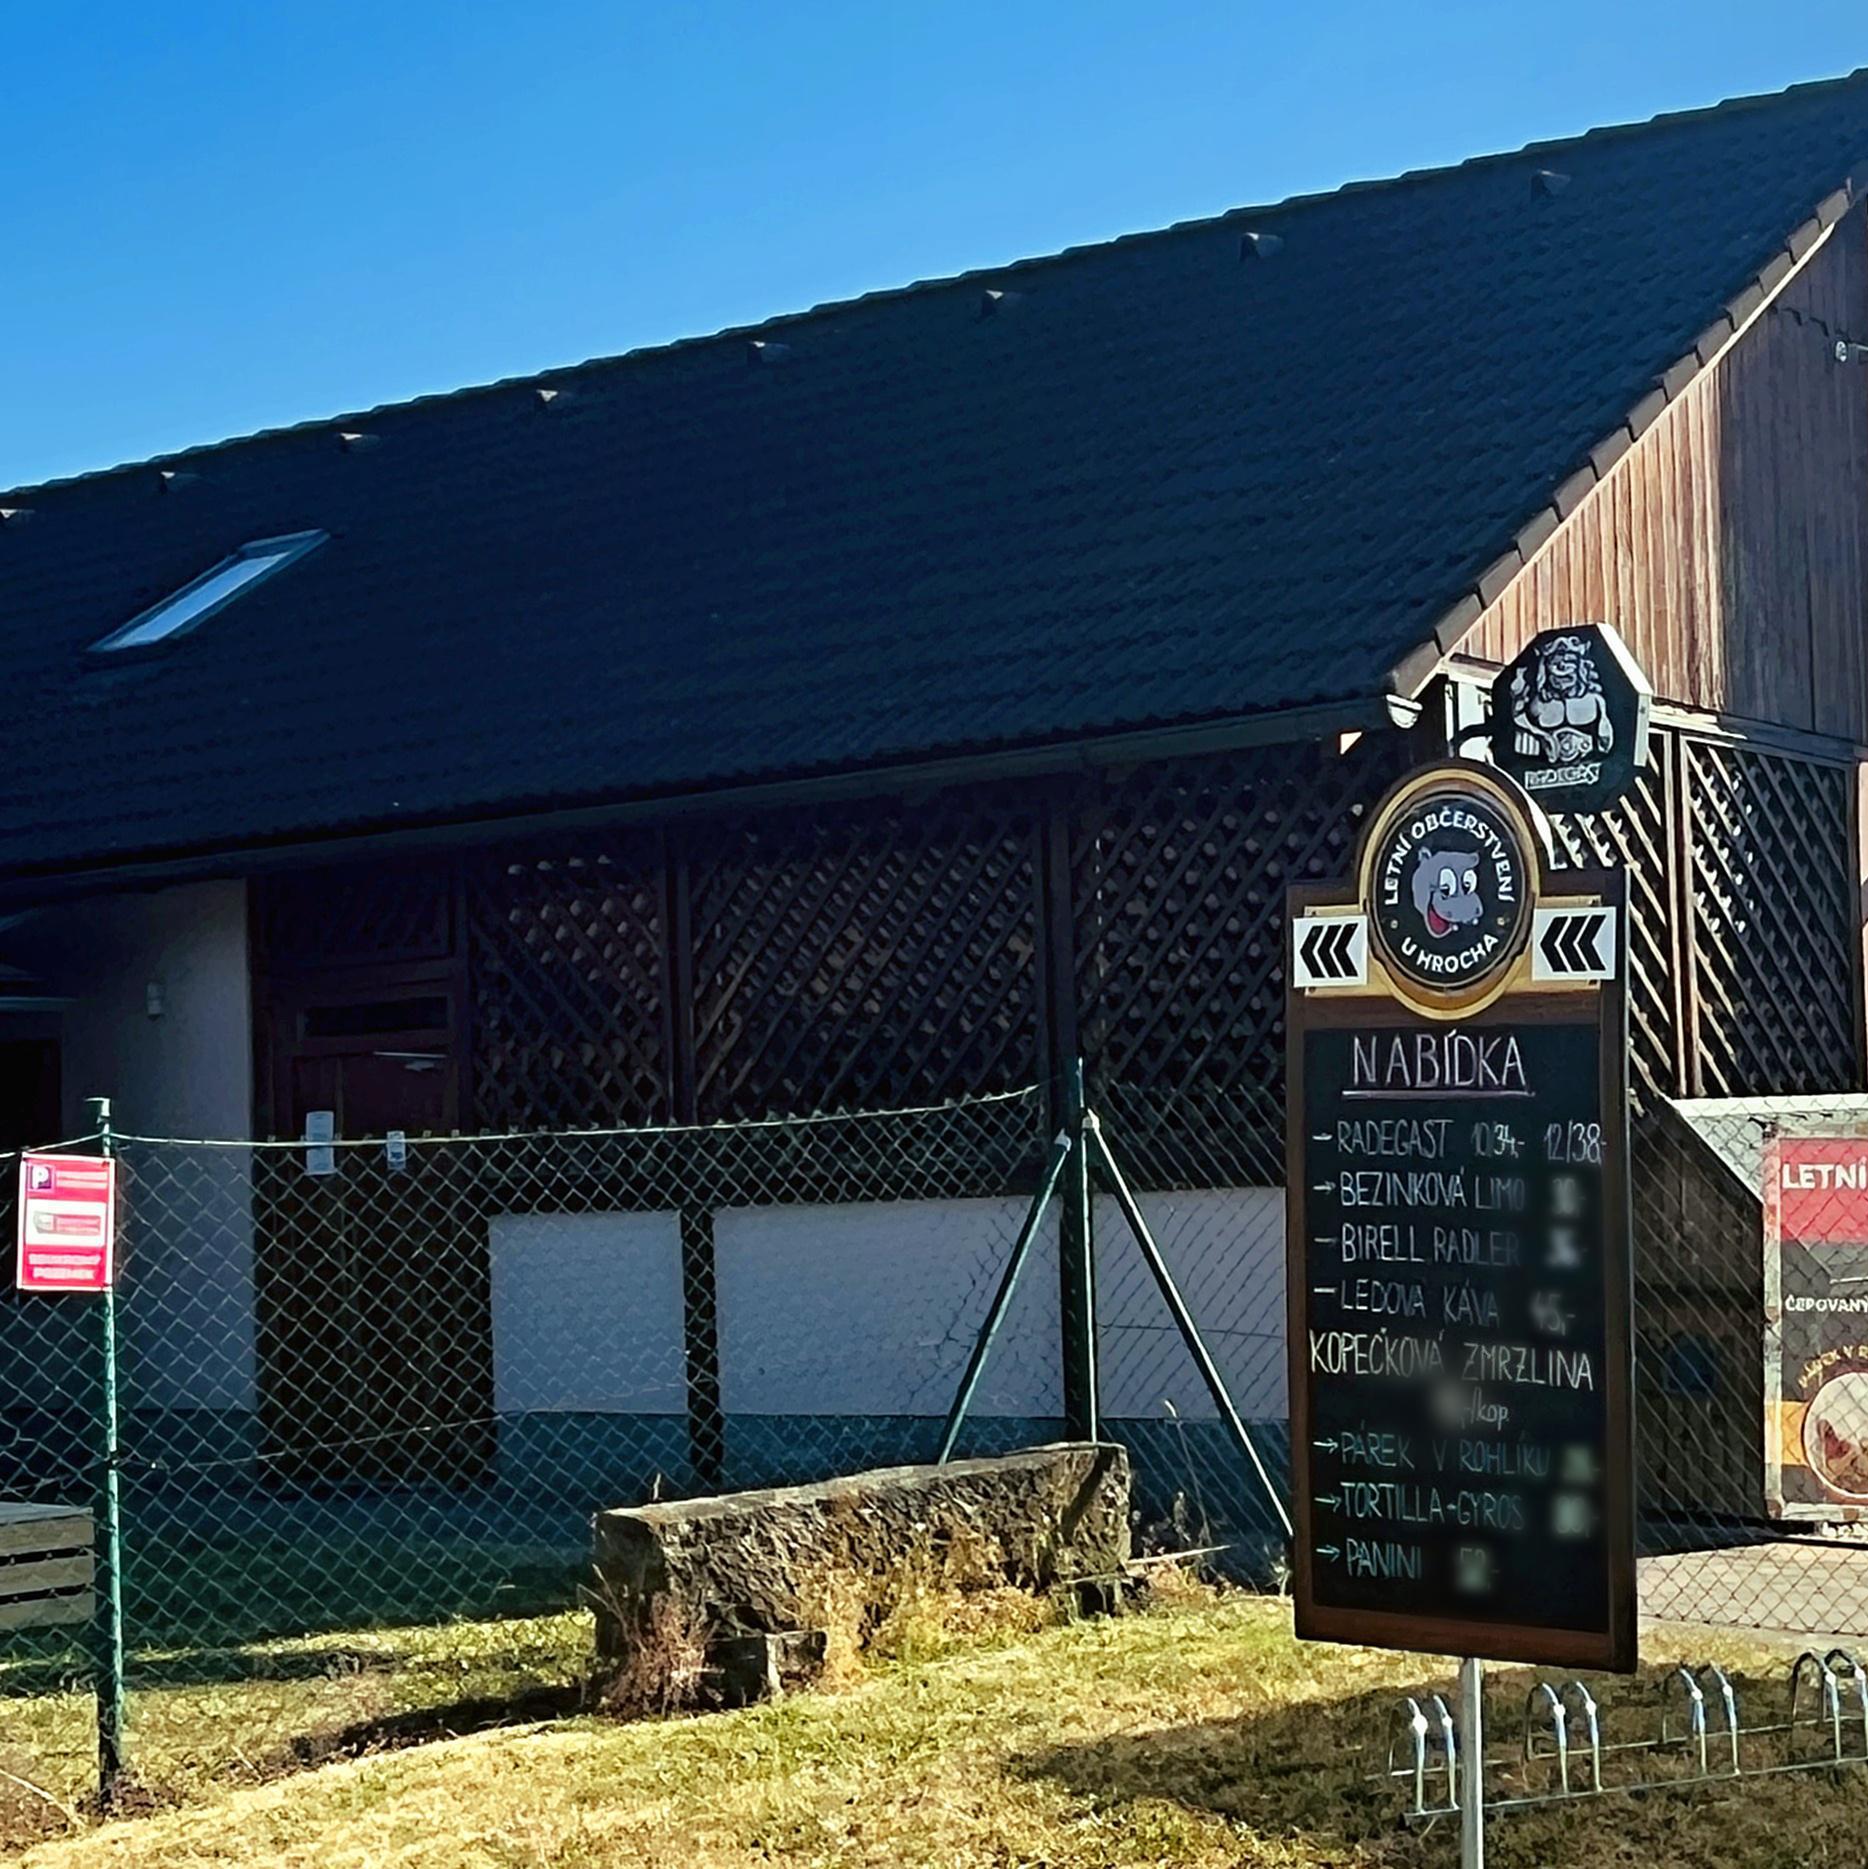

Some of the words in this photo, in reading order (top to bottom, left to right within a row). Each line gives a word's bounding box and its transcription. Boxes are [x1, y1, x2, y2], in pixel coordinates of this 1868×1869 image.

[1384, 831, 1413, 905] LETNÍ
[1413, 805, 1515, 902] OBČERSTVENÍ
[1400, 937, 1416, 957] U
[1415, 933, 1499, 974] HROCHA
[1352, 1029, 1527, 1087] NABÍDKA
[1336, 1119, 1453, 1158] RADEGAST
[1340, 1167, 1467, 1207] BEZINKOVÁ
[1475, 1175, 1526, 1211] LIMO
[1781, 1157, 1868, 1191] LETNÍ
[1341, 1223, 1425, 1263] BIRELL
[1433, 1228, 1521, 1267] RADLER
[1443, 1280, 1500, 1329] KÁVA
[1309, 1327, 1445, 1376] KOPEČKOVÁ
[1461, 1342, 1594, 1391] ZMRZLINA
[1341, 1421, 1415, 1469] PÁREK
[1433, 1439, 1448, 1471] V
[1459, 1431, 1551, 1477] ROHLÍKU
[1345, 1538, 1422, 1580] PANINI
